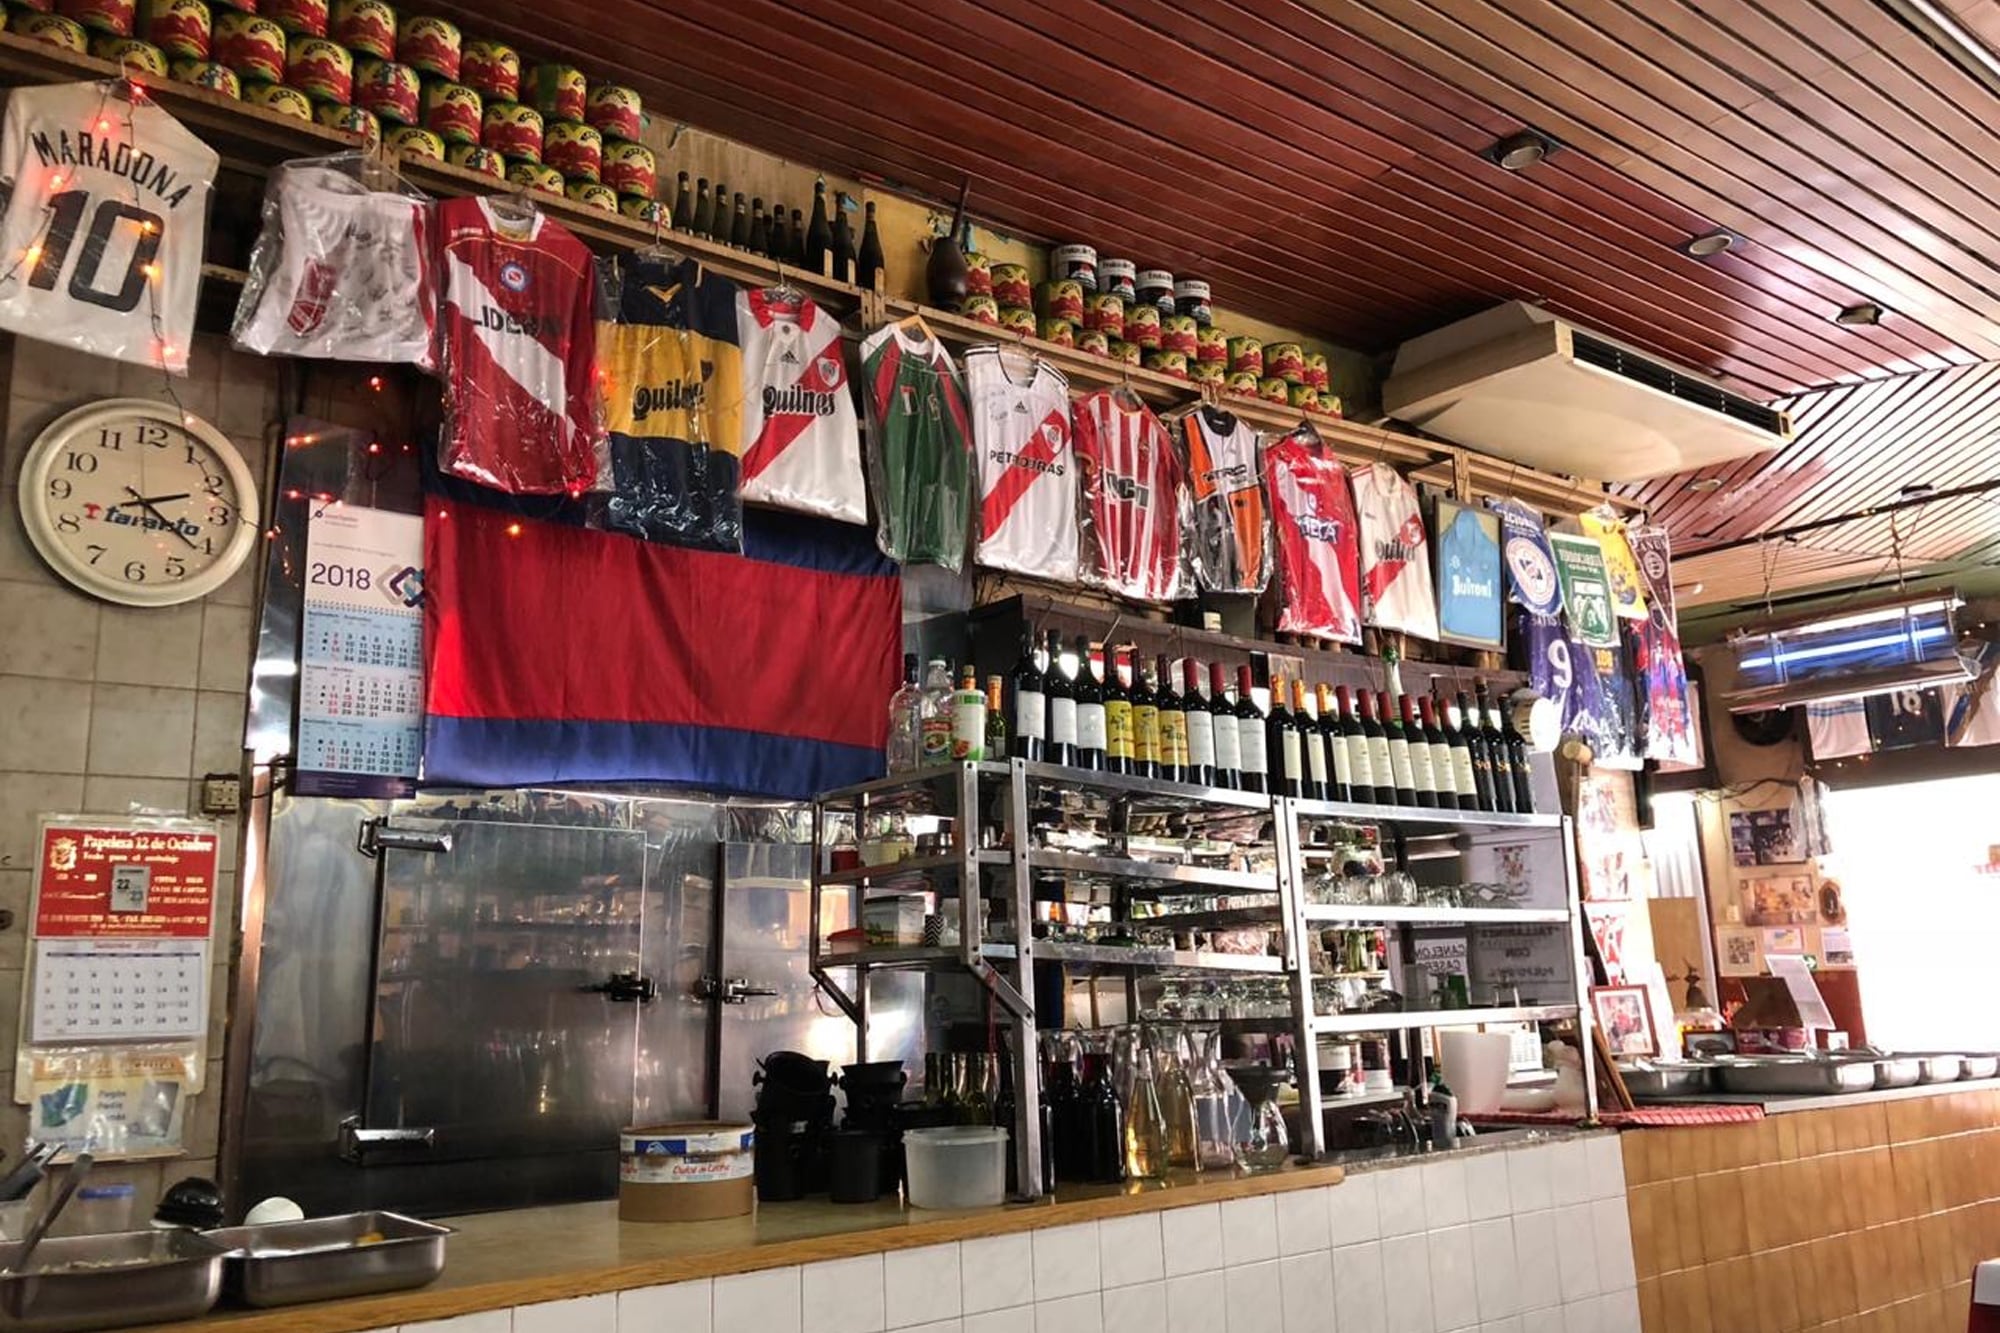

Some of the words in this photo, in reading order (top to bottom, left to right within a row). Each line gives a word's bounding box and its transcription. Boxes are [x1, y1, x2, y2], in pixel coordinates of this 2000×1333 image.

[32, 130, 192, 208] MARADONA
[28, 190, 164, 312] 10
[99, 429, 121, 450] 11
[135, 425, 168, 448] 12
[66, 452, 98, 473] 10
[185, 446, 201, 465] 1
[50, 478, 72, 499] 9
[203, 475, 224, 496] 2
[58, 513, 81, 534] 8
[208, 505, 229, 526] 3
[87, 545, 108, 565] 7
[124, 561, 146, 582] 6
[165, 556, 186, 578] 5
[311, 563, 370, 590] 2018
[1548, 639, 1573, 688] 9
[82, 835, 133, 852] Papelera
[135, 836, 149, 849] 12
[150, 837, 166, 849] de
[167, 836, 213, 852] Octubre
[116, 879, 130, 890] 22
